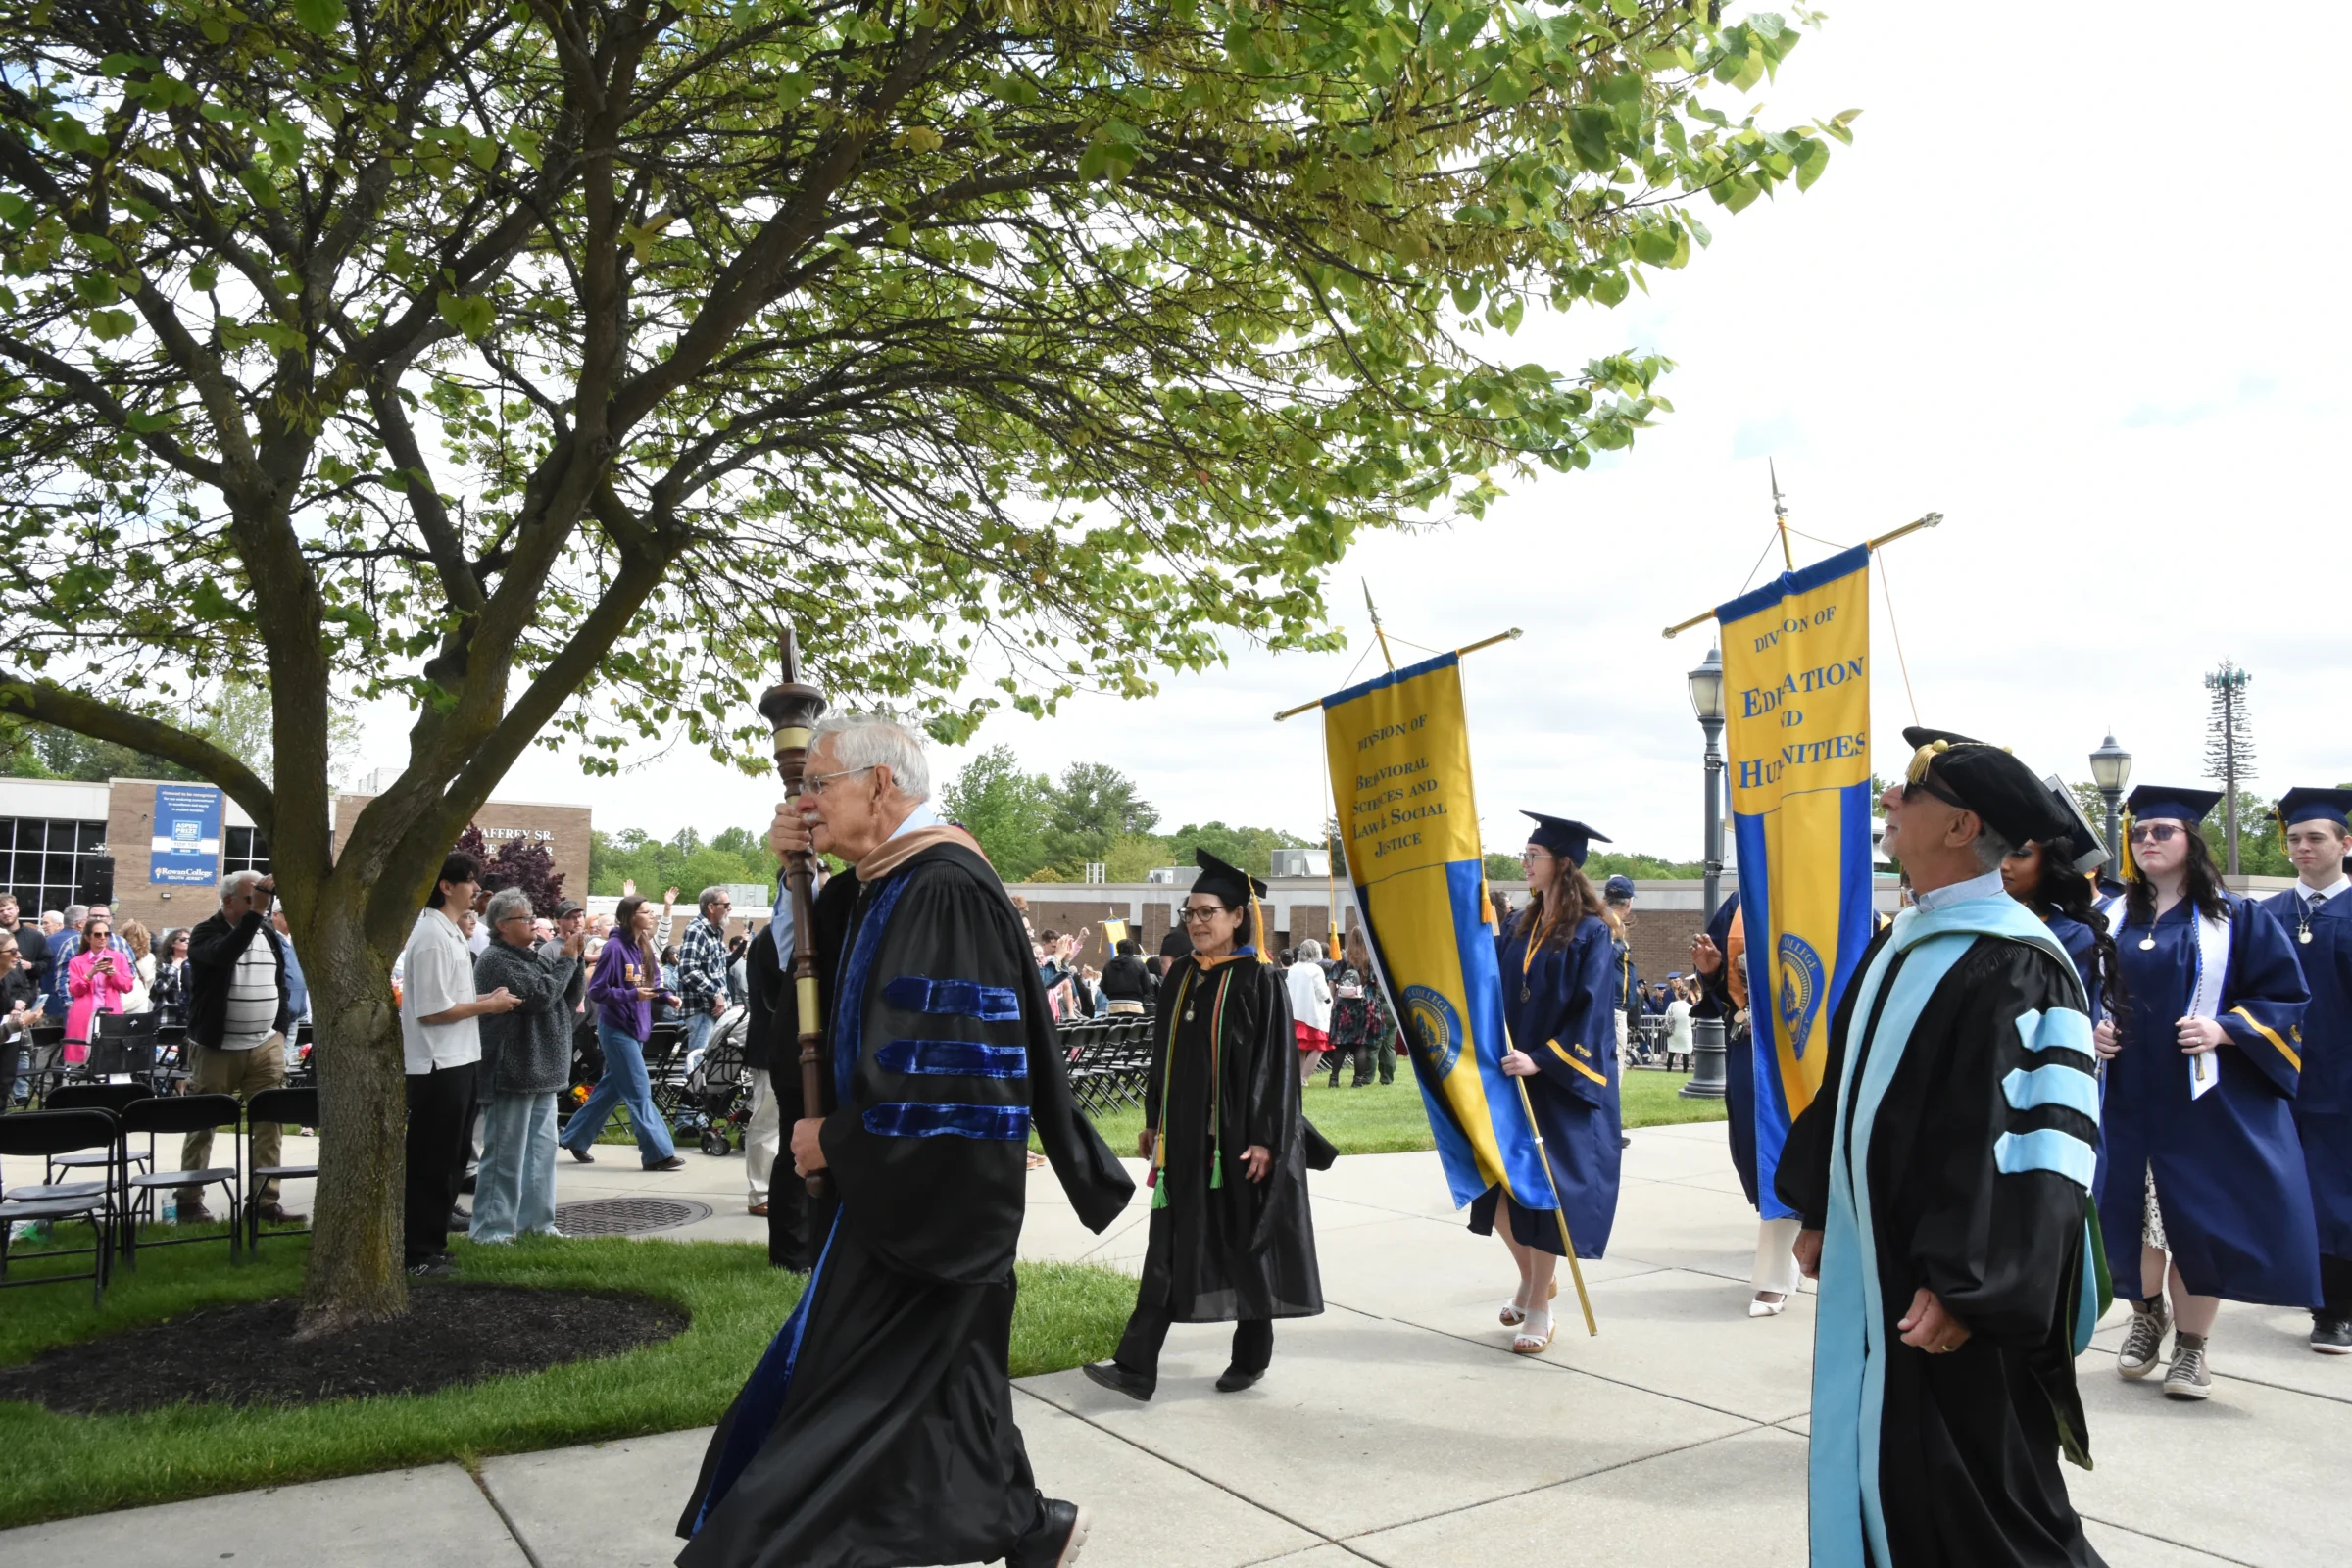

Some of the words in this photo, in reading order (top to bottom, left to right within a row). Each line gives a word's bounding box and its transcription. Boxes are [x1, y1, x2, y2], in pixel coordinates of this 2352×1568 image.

[1754, 615, 1808, 654] DIVON
[1814, 606, 1837, 625] OF
[1740, 657, 1864, 718] EDATION
[1410, 714, 1427, 731] OF
[1739, 731, 1866, 789] HUNITIES
[1352, 788, 1404, 816] SCIECES
[1409, 779, 1438, 798] AND
[534, 830, 555, 841] SR.
[1352, 821, 1379, 840] LAW
[1391, 803, 1447, 826] SOCIAL
[1375, 832, 1422, 858] JSTICE
[1783, 937, 1818, 972] OLLEGE
